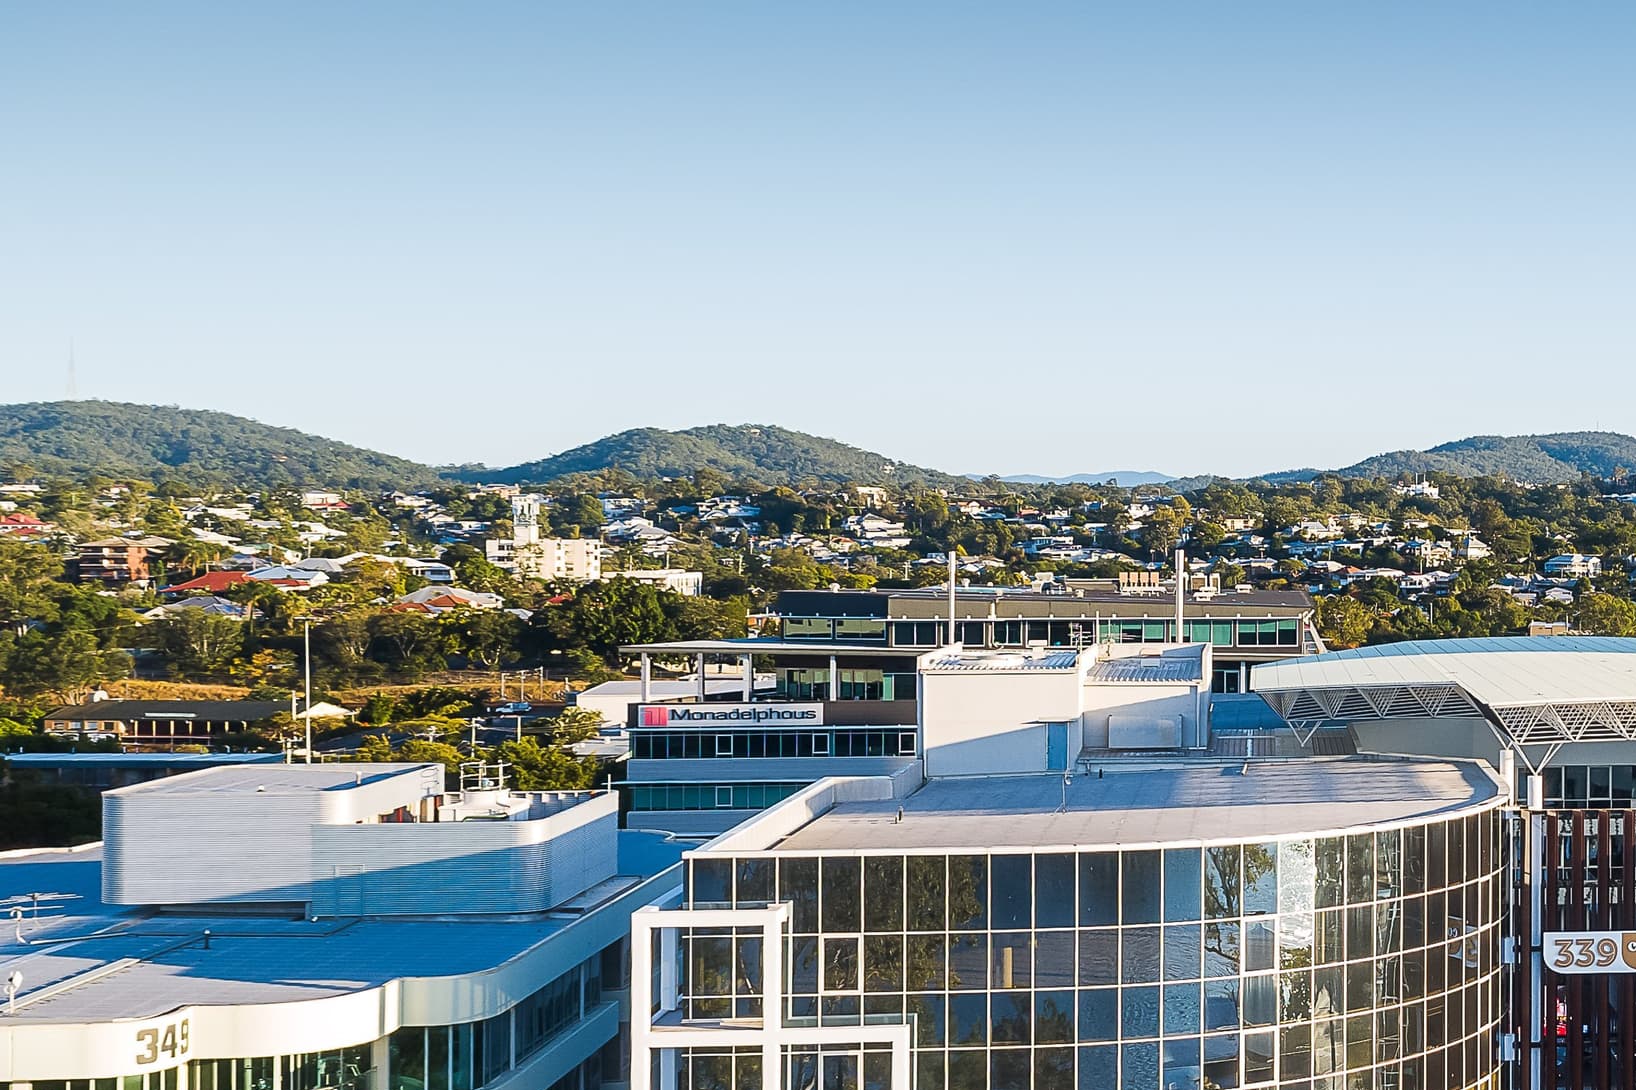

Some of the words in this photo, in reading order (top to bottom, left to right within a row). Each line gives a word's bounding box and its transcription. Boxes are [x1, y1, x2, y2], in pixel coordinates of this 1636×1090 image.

[669, 708, 817, 722] Monadelphous
[1554, 938, 1618, 967] 339
[135, 1018, 189, 1065] 349
